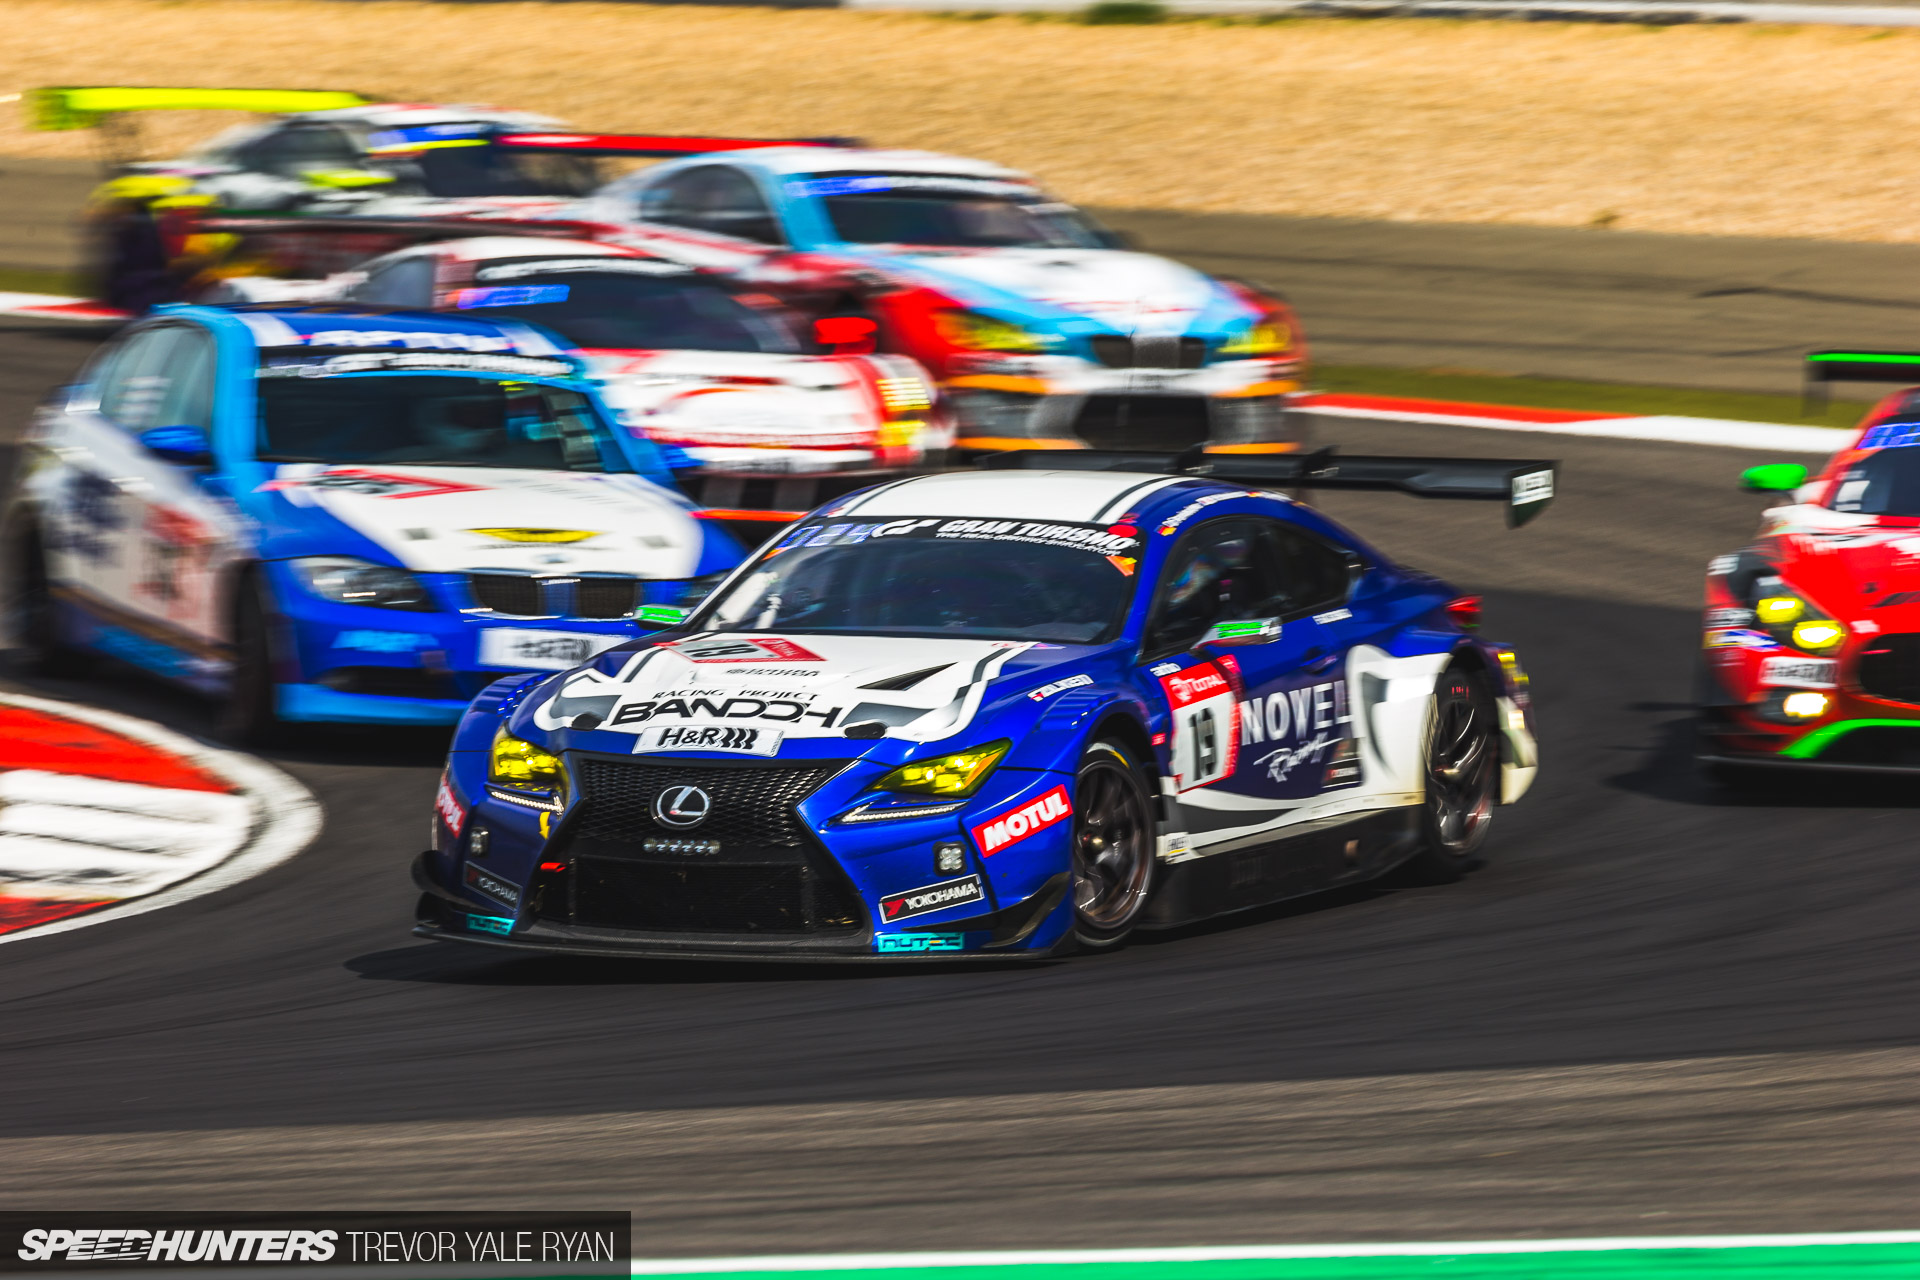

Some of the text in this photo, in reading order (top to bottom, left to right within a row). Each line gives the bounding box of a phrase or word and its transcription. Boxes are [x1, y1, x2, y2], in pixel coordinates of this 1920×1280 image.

[937, 519, 1136, 551] GRAN TURISMO
[653, 688, 821, 701] RACING PROJECT
[1238, 679, 1354, 747] NOVEL
[982, 792, 1069, 852] MOTUL
[904, 882, 978, 910] YOKOHAMA
